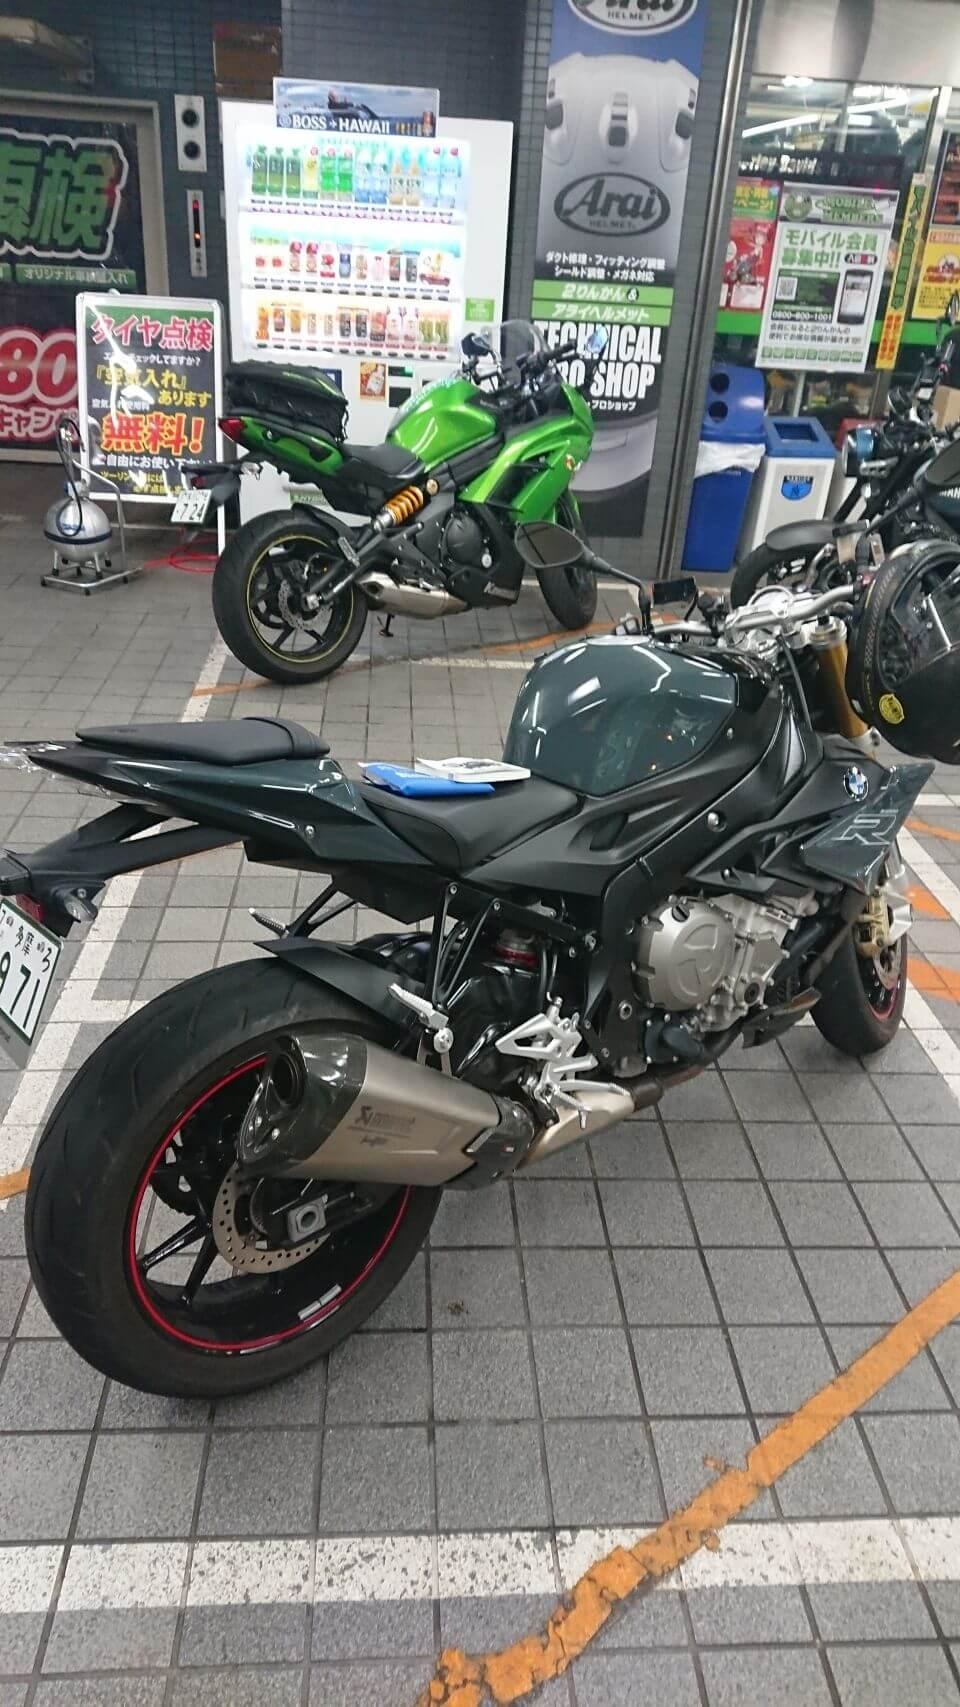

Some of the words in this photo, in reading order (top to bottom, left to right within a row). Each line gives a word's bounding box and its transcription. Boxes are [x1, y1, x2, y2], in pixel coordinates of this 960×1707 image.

[292, 114, 327, 129] BOSS
[338, 118, 390, 134] HAWAII
[563, 178, 657, 220] Arai
[785, 228, 879, 251] モバイル会員
[551, 303, 649, 322] アライヘルメット
[91, 314, 214, 352] タイヤ点検
[590, 360, 656, 399] SHOP
[158, 390, 212, 408] あります
[101, 412, 205, 456] 無料!
